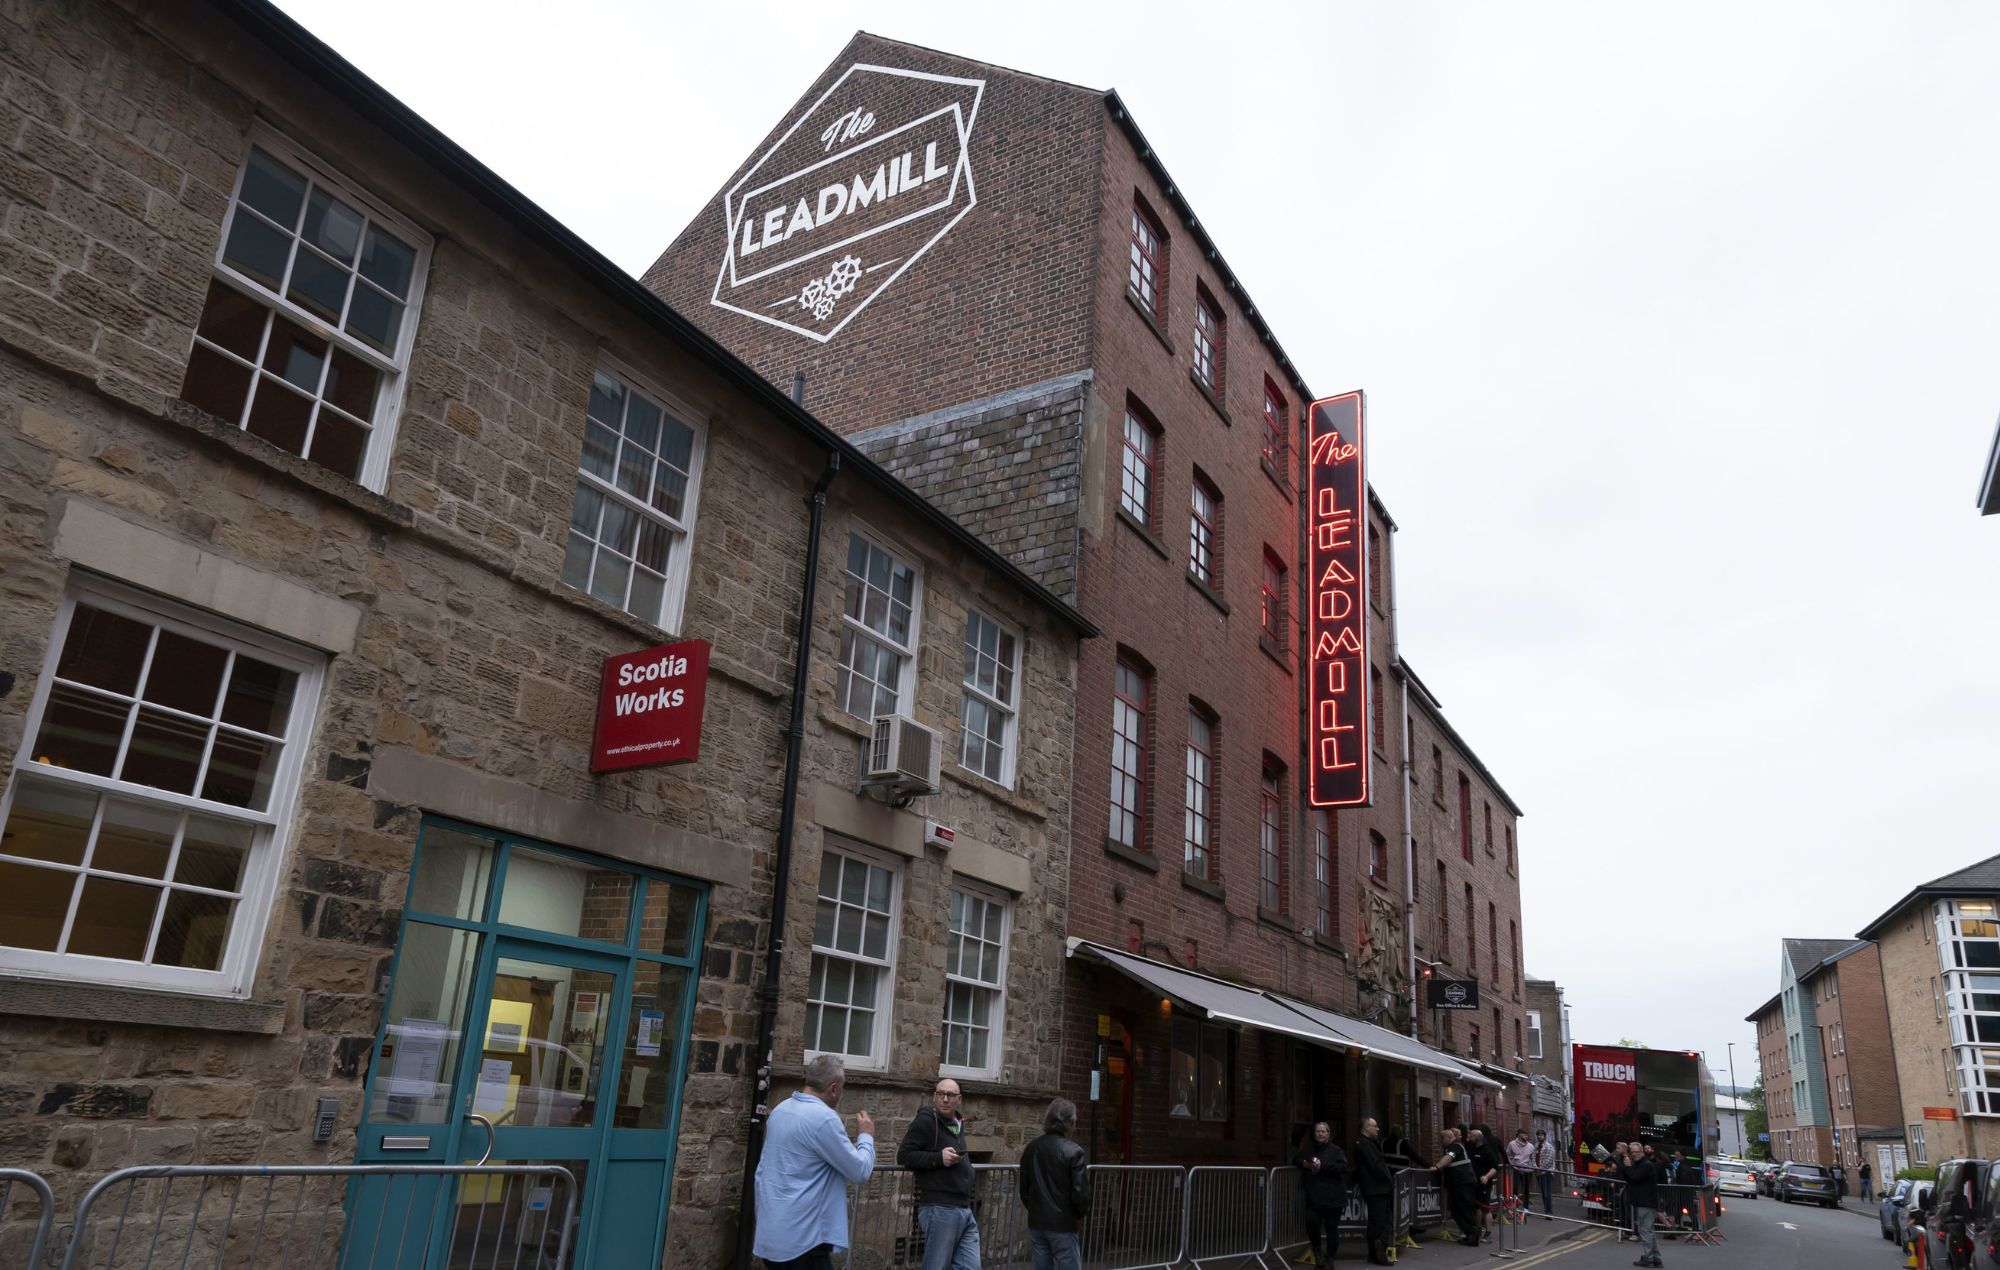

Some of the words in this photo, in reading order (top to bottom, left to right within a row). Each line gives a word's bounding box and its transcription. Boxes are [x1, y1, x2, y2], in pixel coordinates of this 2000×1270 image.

[820, 106, 876, 152] The
[740, 141, 949, 257] LEADMILL
[1311, 431, 1357, 465] The
[1315, 487, 1361, 769] LEADMILL
[618, 655, 687, 686] Scotia
[615, 687, 684, 716] Works
[606, 737, 680, 755] www.ethicalproperty.co.uk
